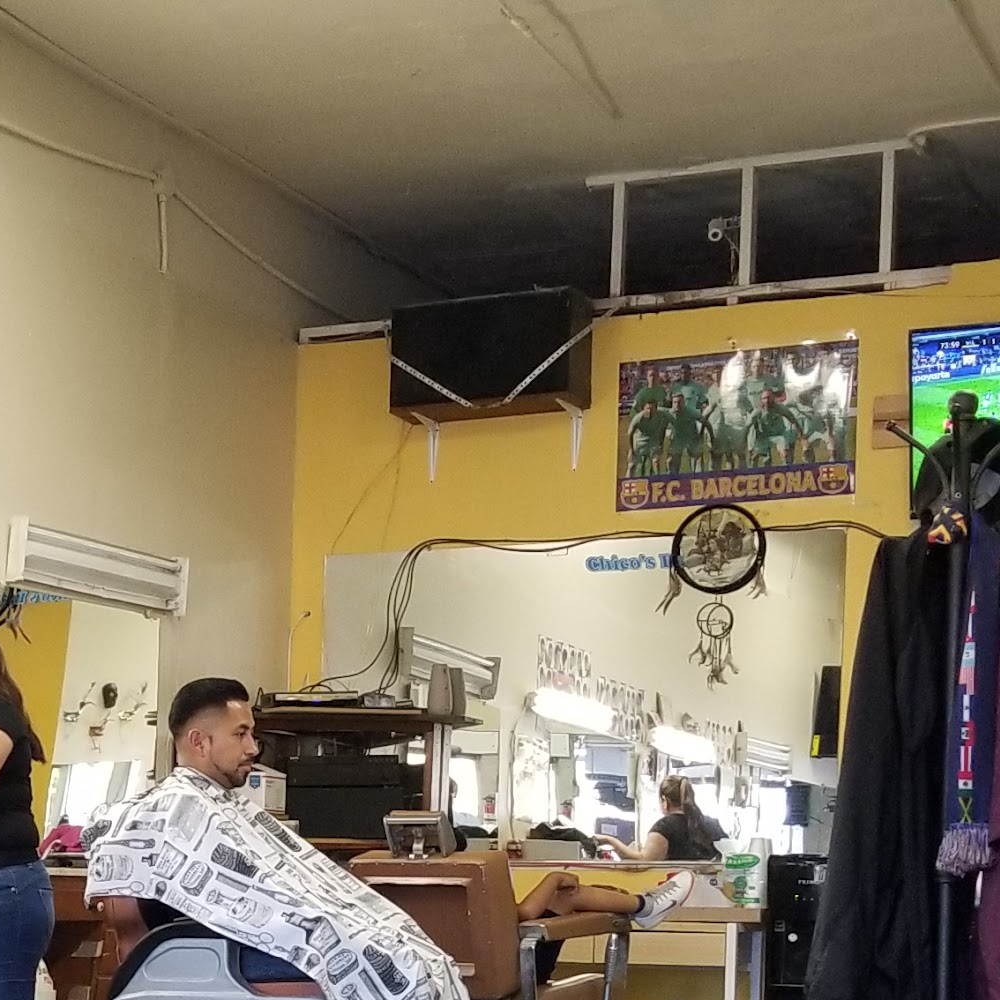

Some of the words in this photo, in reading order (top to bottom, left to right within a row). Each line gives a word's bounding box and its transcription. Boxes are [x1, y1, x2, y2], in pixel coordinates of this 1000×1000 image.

[651, 481, 686, 503] F.C.
[691, 470, 818, 500] BARCELONA
[586, 554, 657, 572] Chico's
